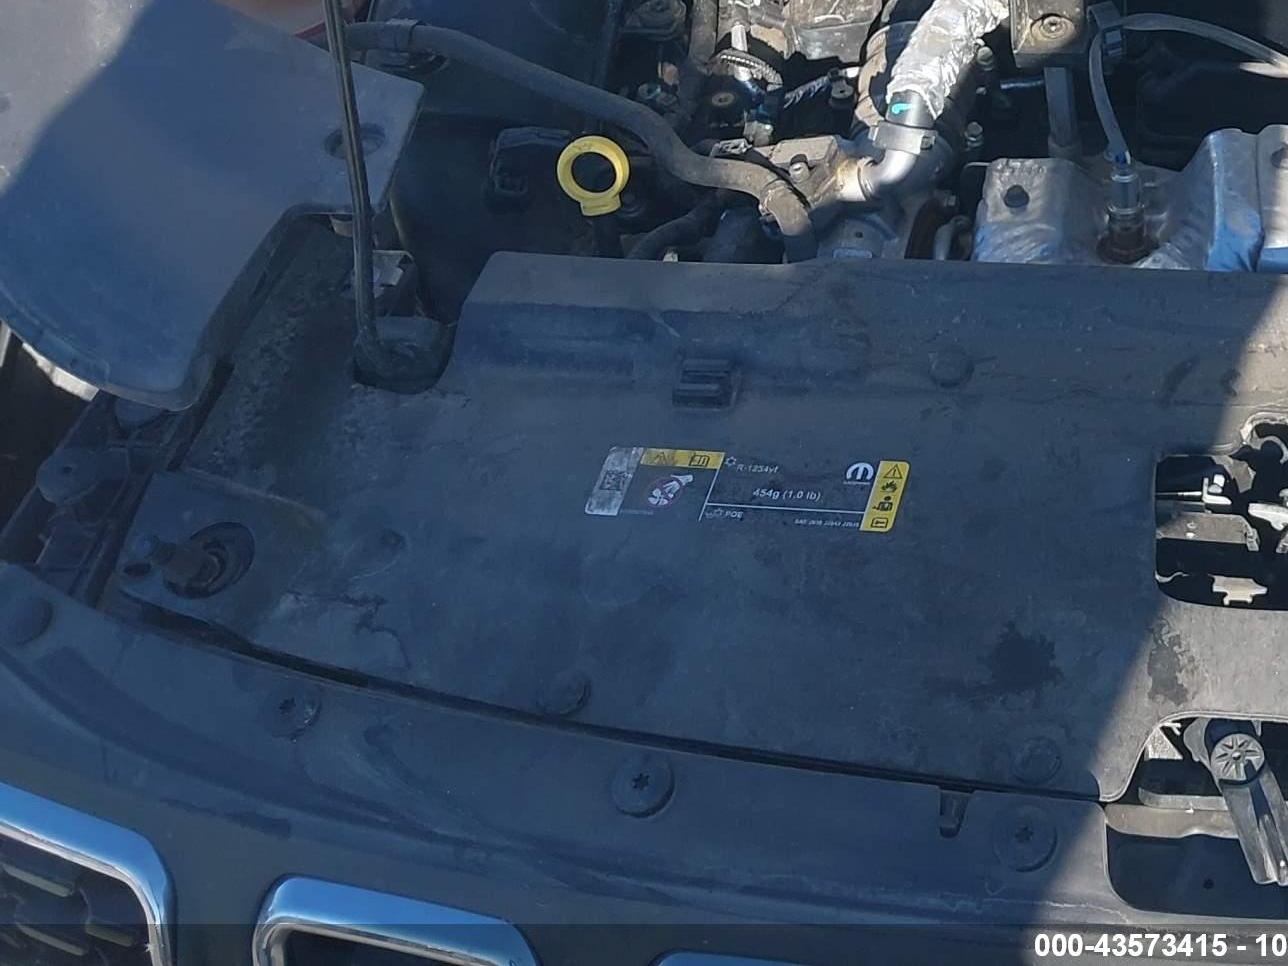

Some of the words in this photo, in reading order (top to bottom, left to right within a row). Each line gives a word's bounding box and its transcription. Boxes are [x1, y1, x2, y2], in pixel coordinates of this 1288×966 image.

[736, 464, 779, 474] R-1234yf
[753, 488, 780, 500] 454g
[782, 490, 804, 500] (1.0
[806, 491, 821, 502] lb)
[724, 511, 744, 519] POE
